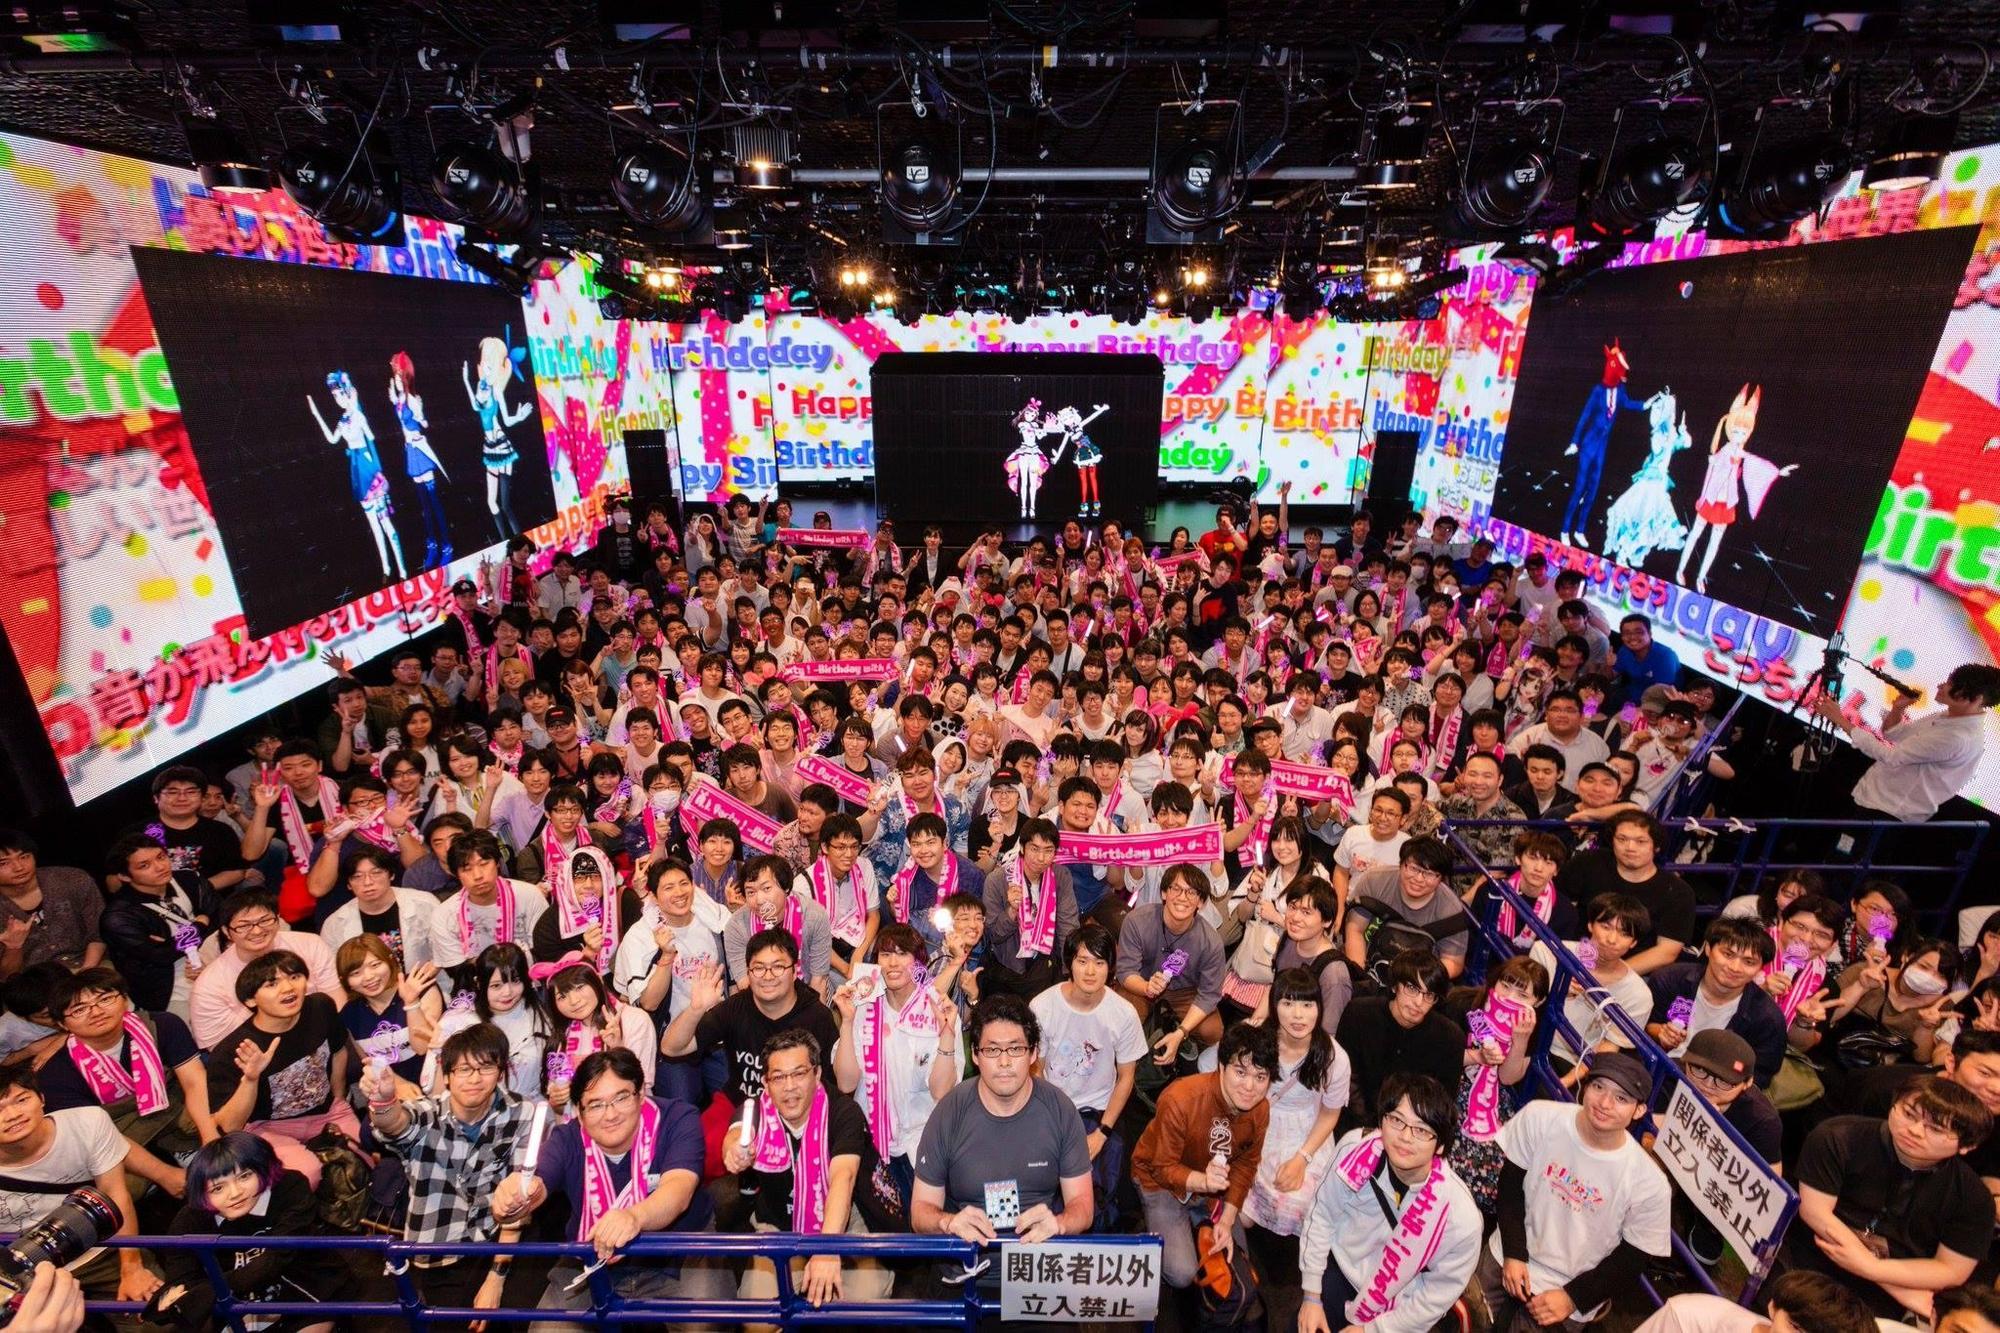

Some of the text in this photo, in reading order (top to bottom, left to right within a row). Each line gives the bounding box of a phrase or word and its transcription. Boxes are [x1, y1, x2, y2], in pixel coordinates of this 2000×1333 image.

[1662, 1127, 1757, 1252] 立入禁止
[1673, 1092, 1771, 1217] 関係者以外
[1007, 1252, 1155, 1288] 関係者以外
[1020, 1293, 1136, 1318] 立入禁止
